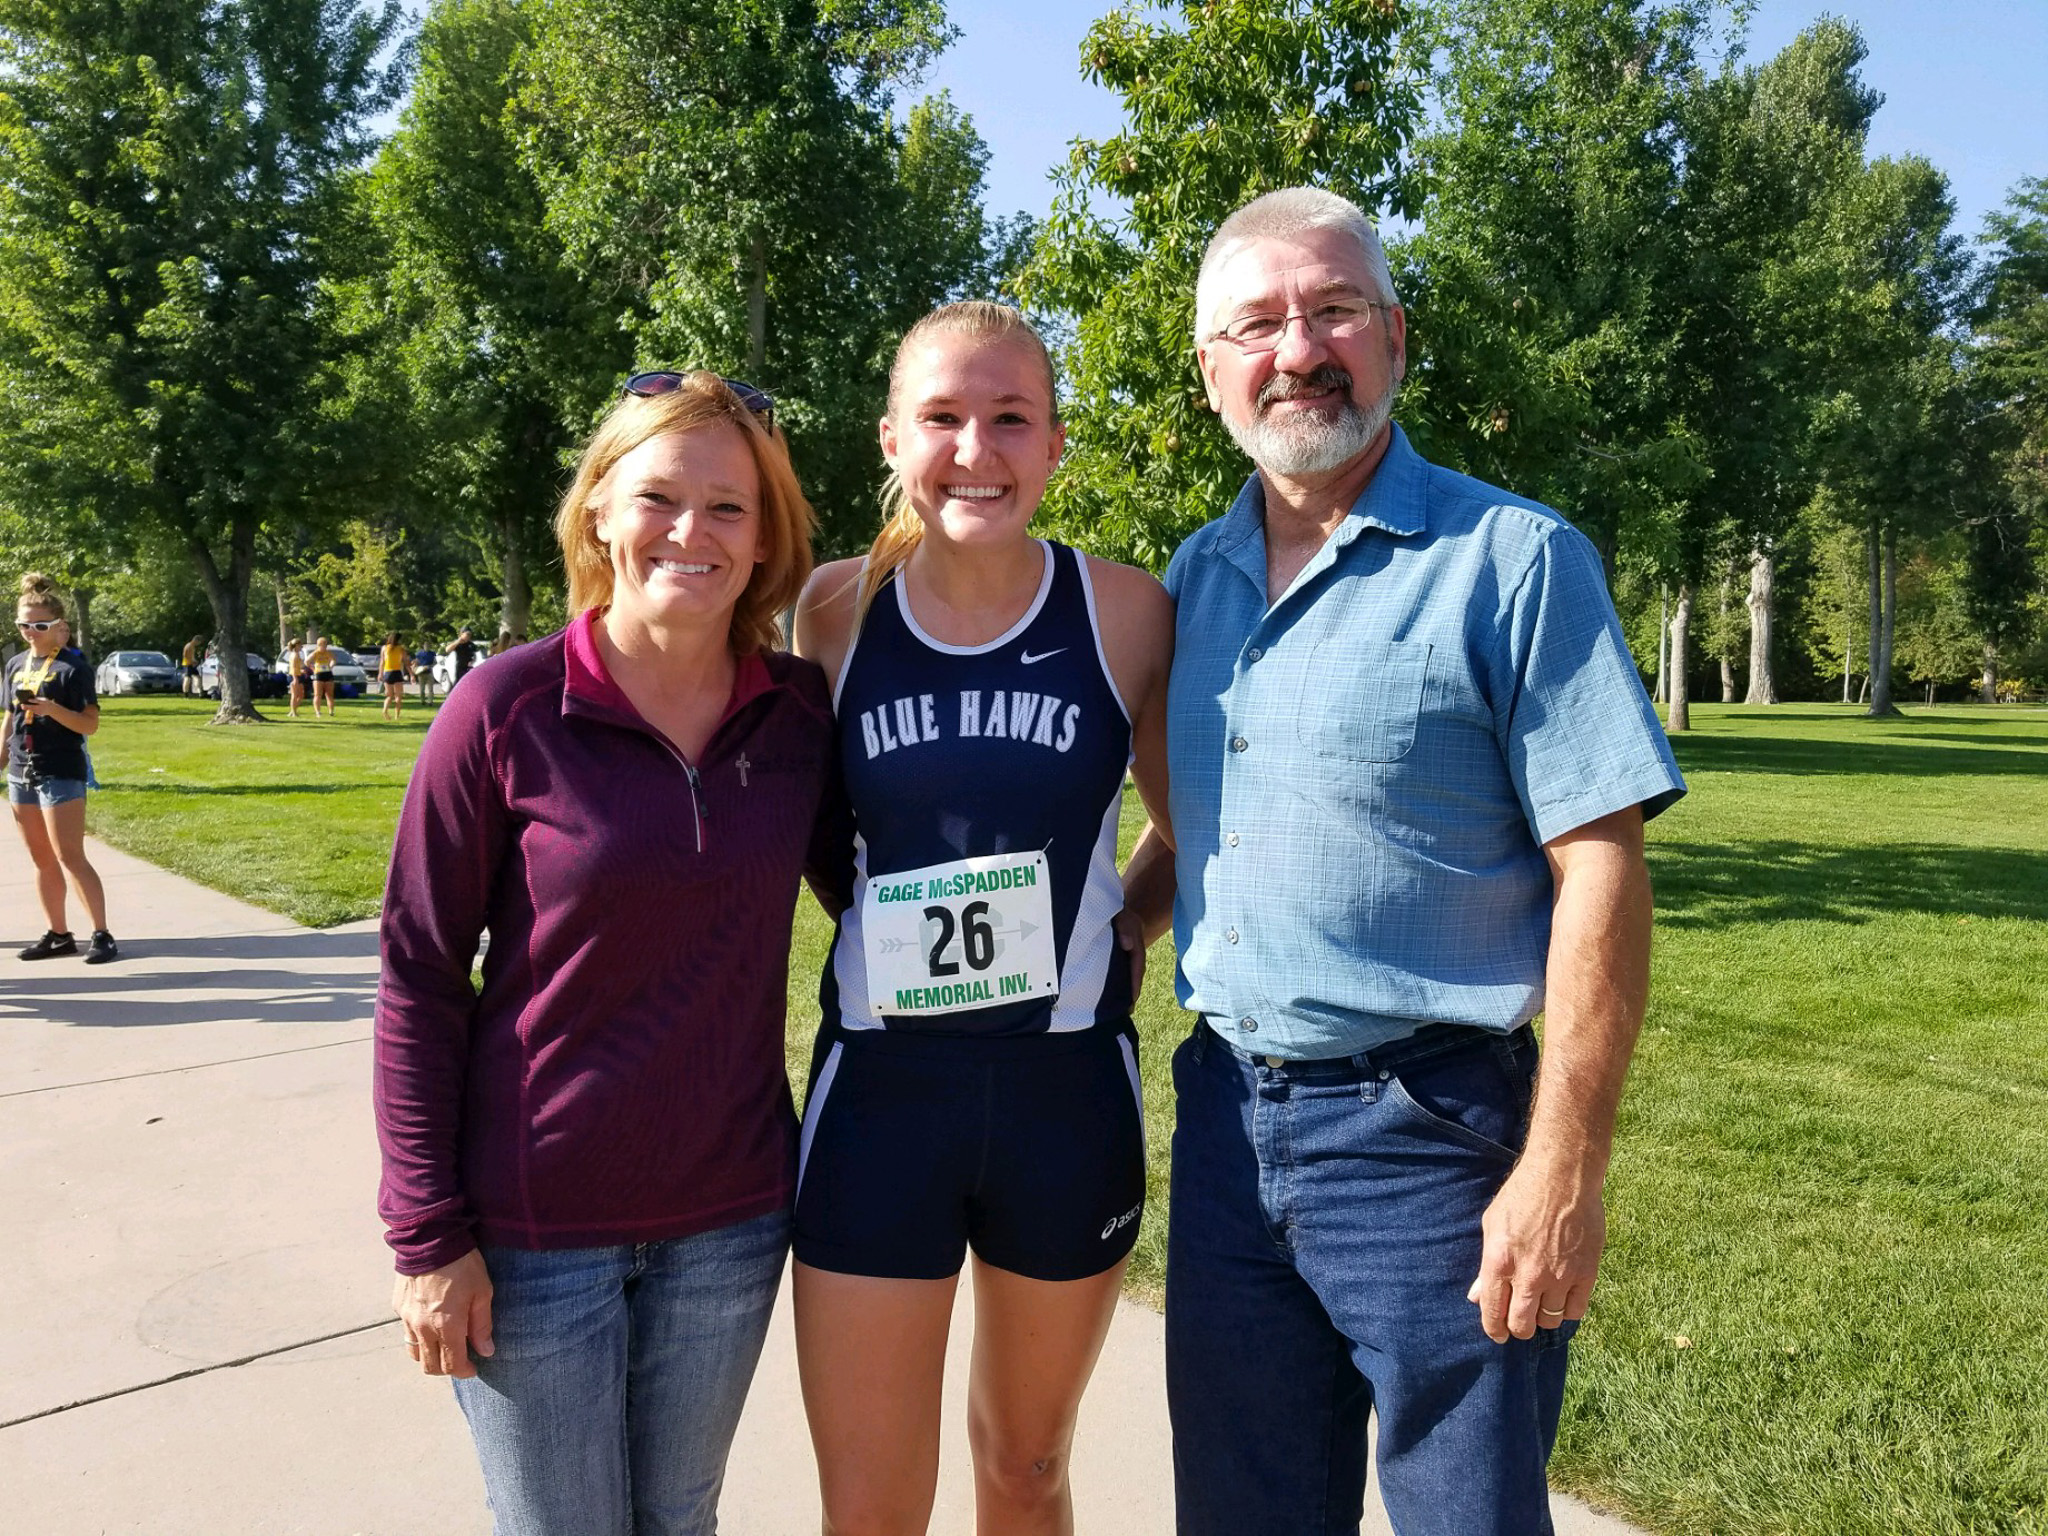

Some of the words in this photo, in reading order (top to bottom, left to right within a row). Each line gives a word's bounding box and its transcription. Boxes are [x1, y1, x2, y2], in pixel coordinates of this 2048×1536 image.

[860, 693, 940, 760] BLUE
[959, 690, 1081, 753] HAWKS
[878, 881, 924, 903] GAGE
[928, 864, 1037, 898] McSPADDEN
[923, 901, 995, 978] 26
[896, 980, 993, 1010] MEMORIAL
[999, 972, 1032, 1001] INV.
